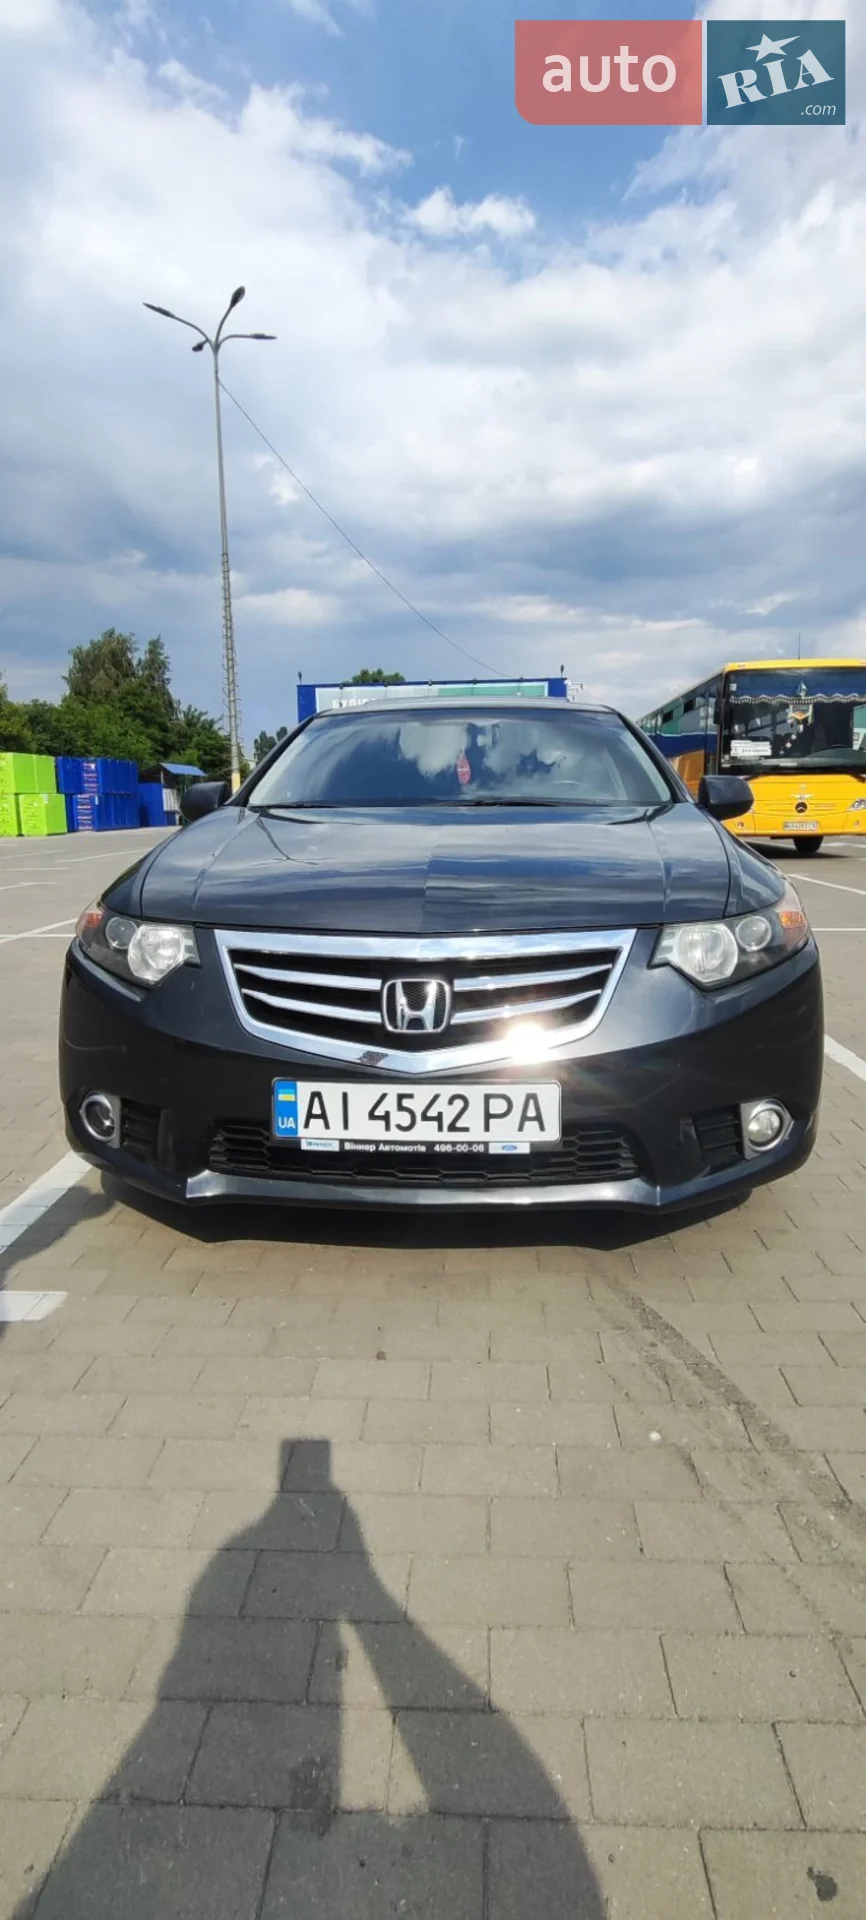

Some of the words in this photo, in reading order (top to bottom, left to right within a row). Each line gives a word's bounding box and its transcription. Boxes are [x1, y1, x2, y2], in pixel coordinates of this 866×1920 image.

[278, 1117, 296, 1129] UA
[303, 1091, 349, 1132] AI
[368, 1092, 470, 1133] 4542
[483, 1093, 546, 1133] PA
